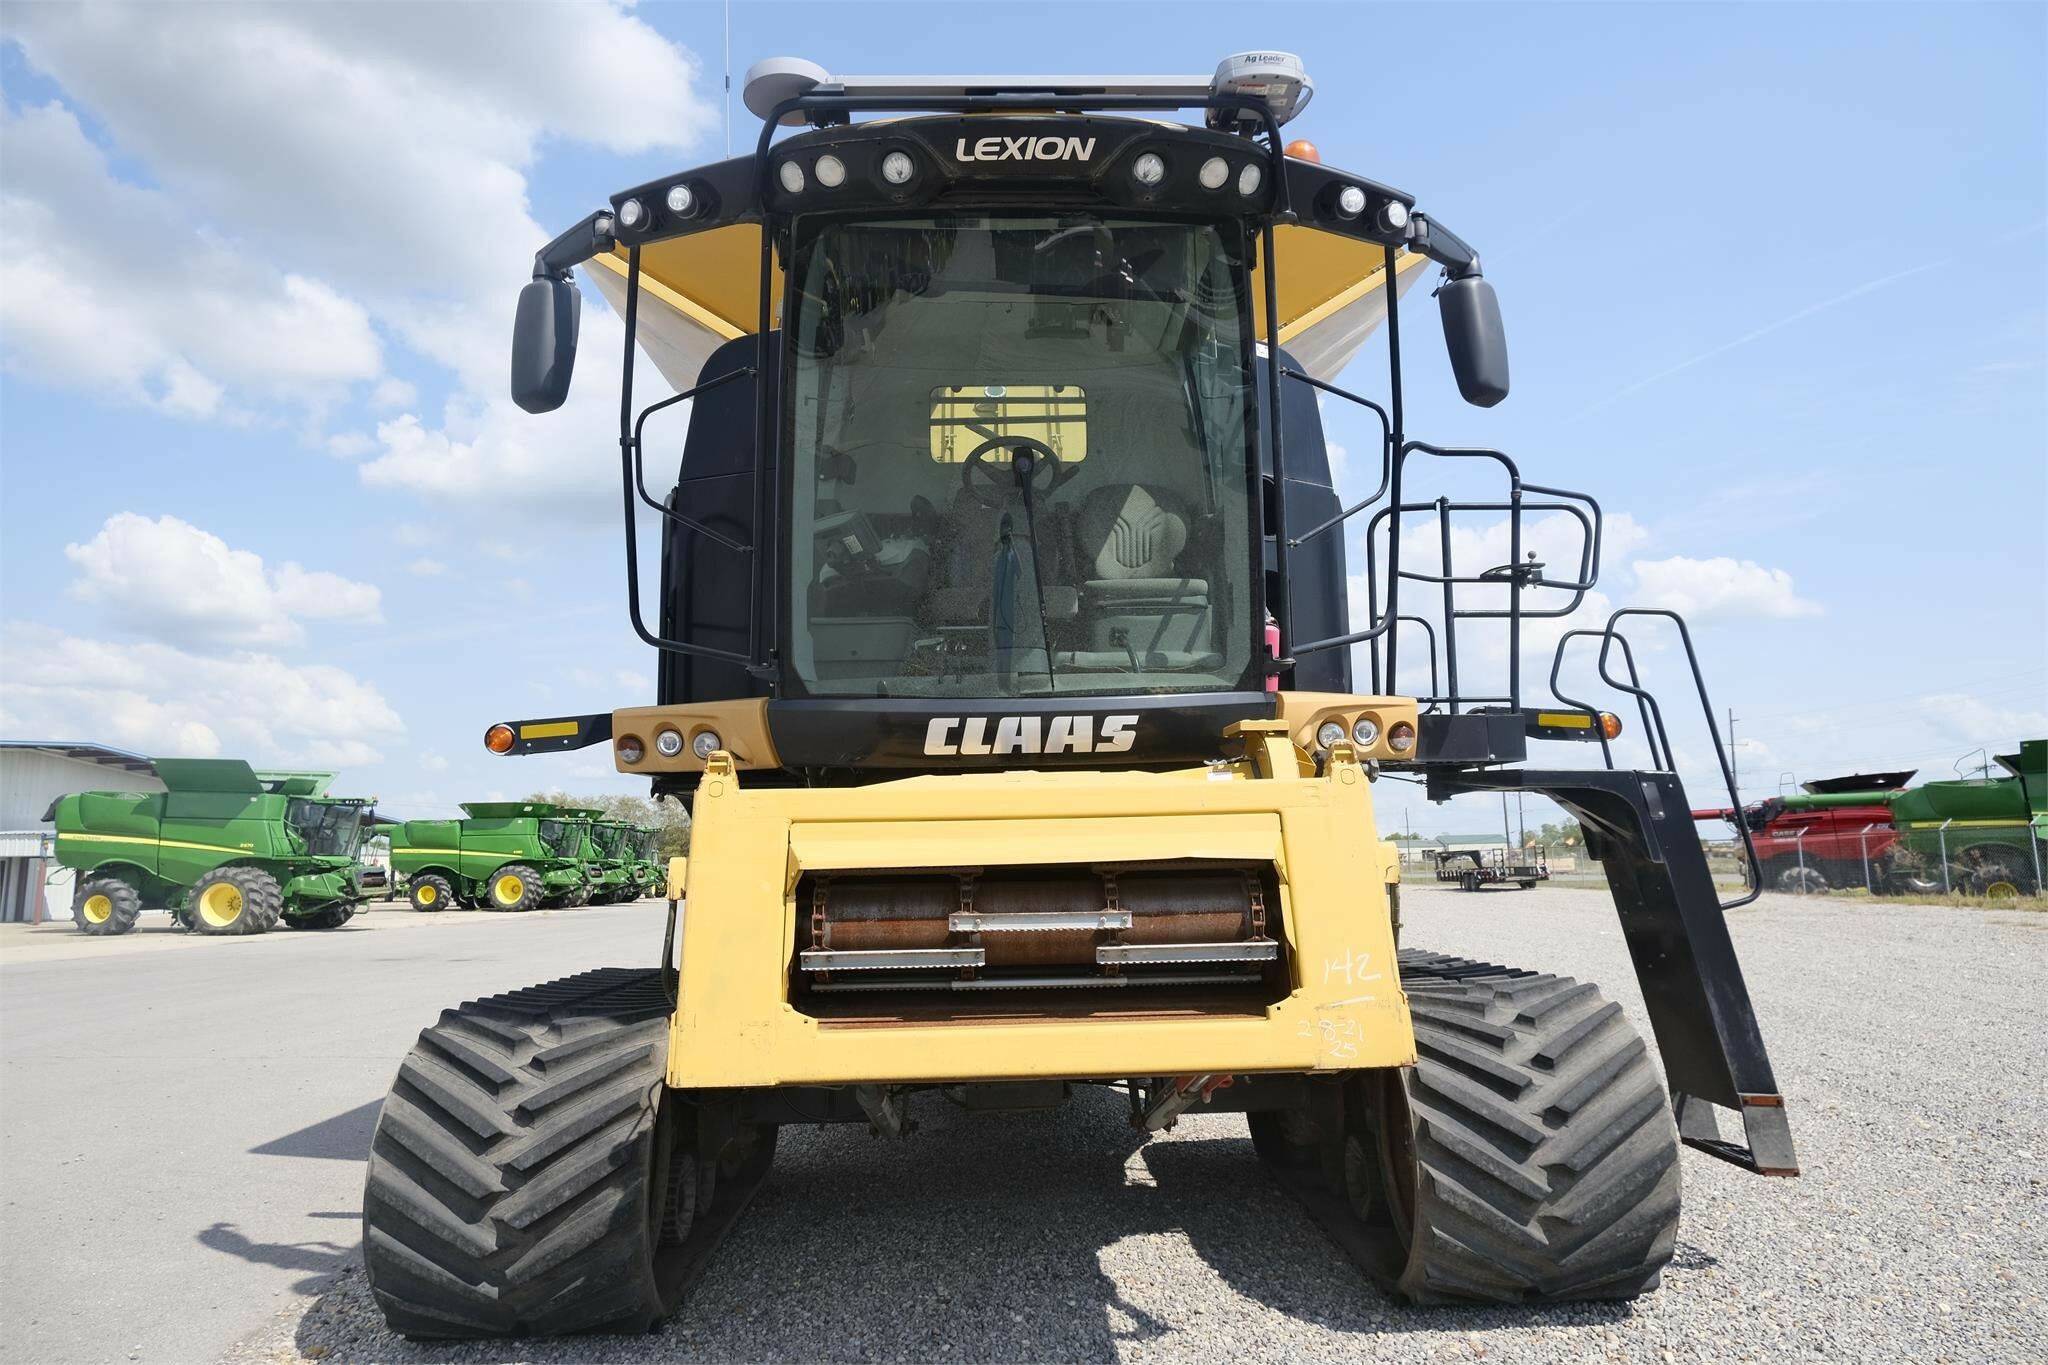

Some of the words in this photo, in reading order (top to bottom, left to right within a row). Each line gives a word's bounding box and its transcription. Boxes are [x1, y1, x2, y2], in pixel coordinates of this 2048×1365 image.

[1244, 55, 1257, 63] Ag
[1259, 54, 1286, 62] Leader
[956, 136, 1096, 162] LEXION
[923, 714, 1140, 756] CLAAS
[1323, 946, 1382, 985] 142
[1329, 1040, 1358, 1058] 25
